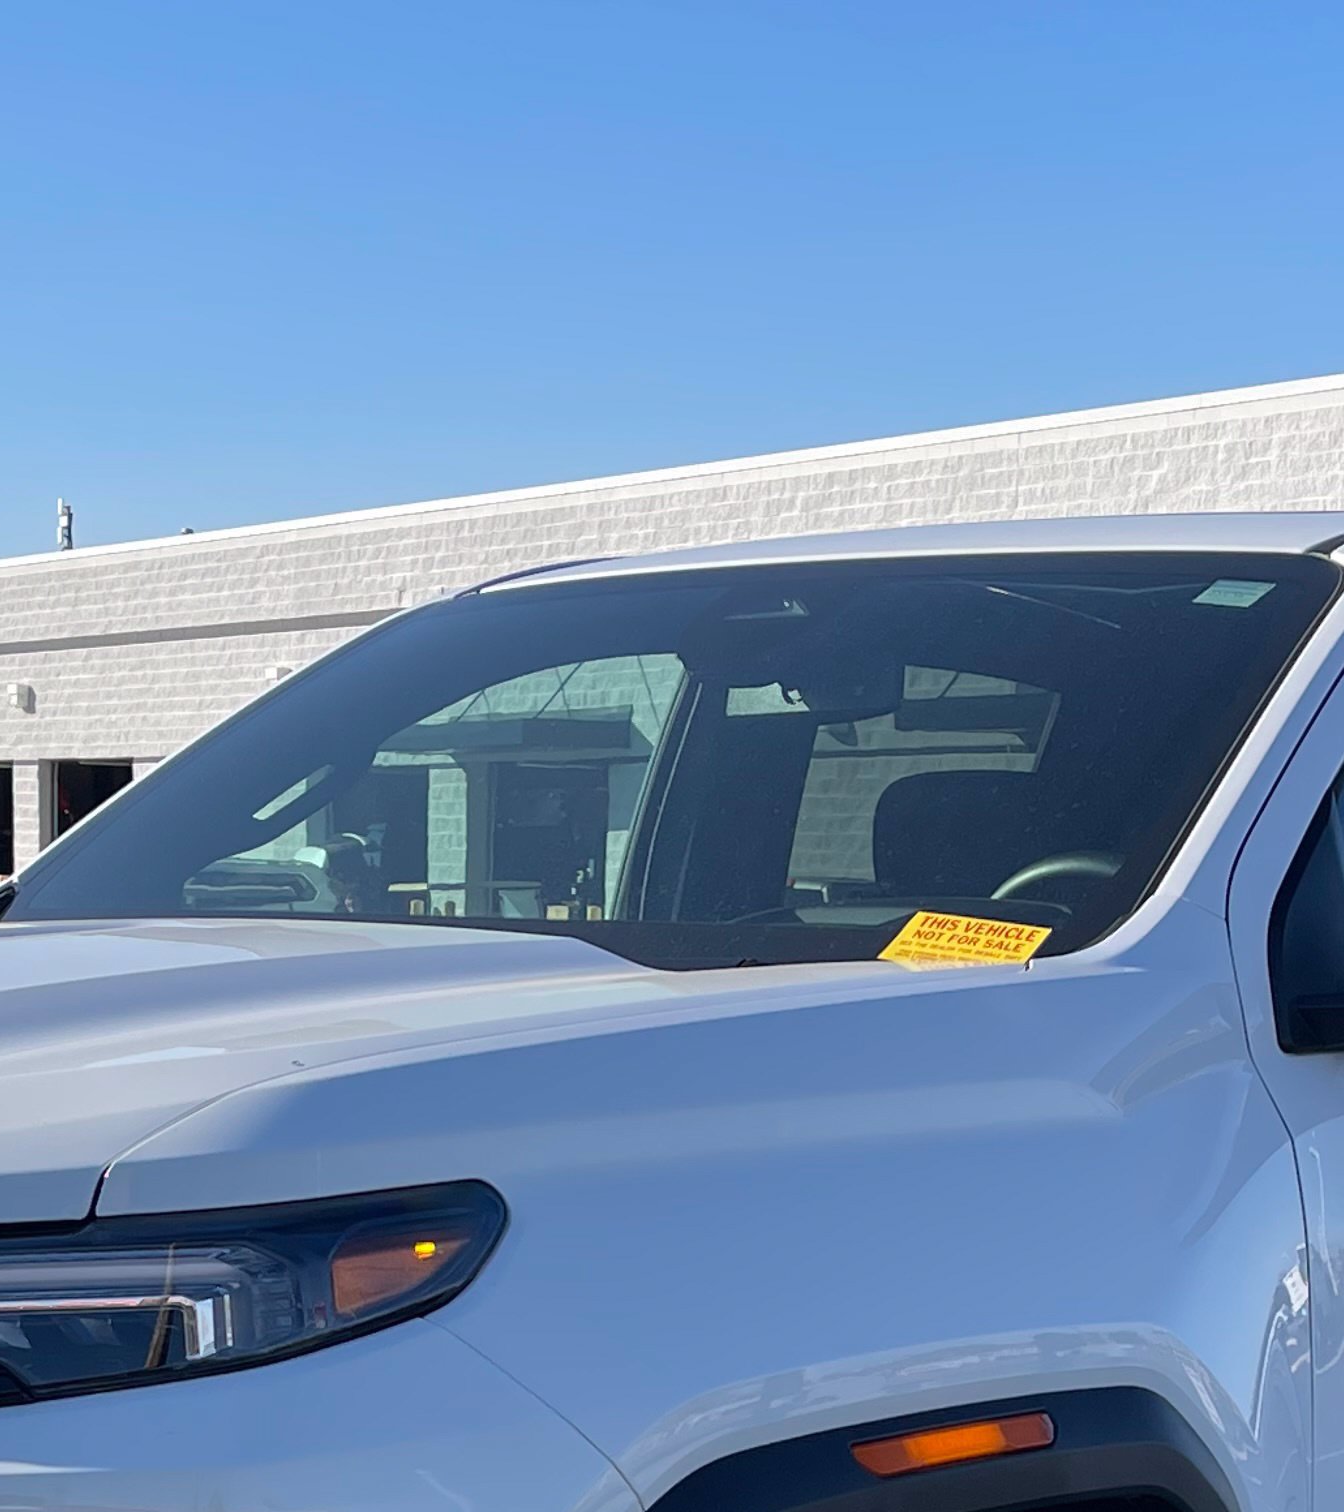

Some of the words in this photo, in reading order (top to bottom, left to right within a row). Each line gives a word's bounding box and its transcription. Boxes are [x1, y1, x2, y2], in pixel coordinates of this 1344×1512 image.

[912, 929, 946, 942] NOT
[947, 934, 981, 946] FOR
[983, 939, 1026, 953] SALE
[920, 915, 962, 931] THIS
[964, 921, 1042, 942] VEHICLE
